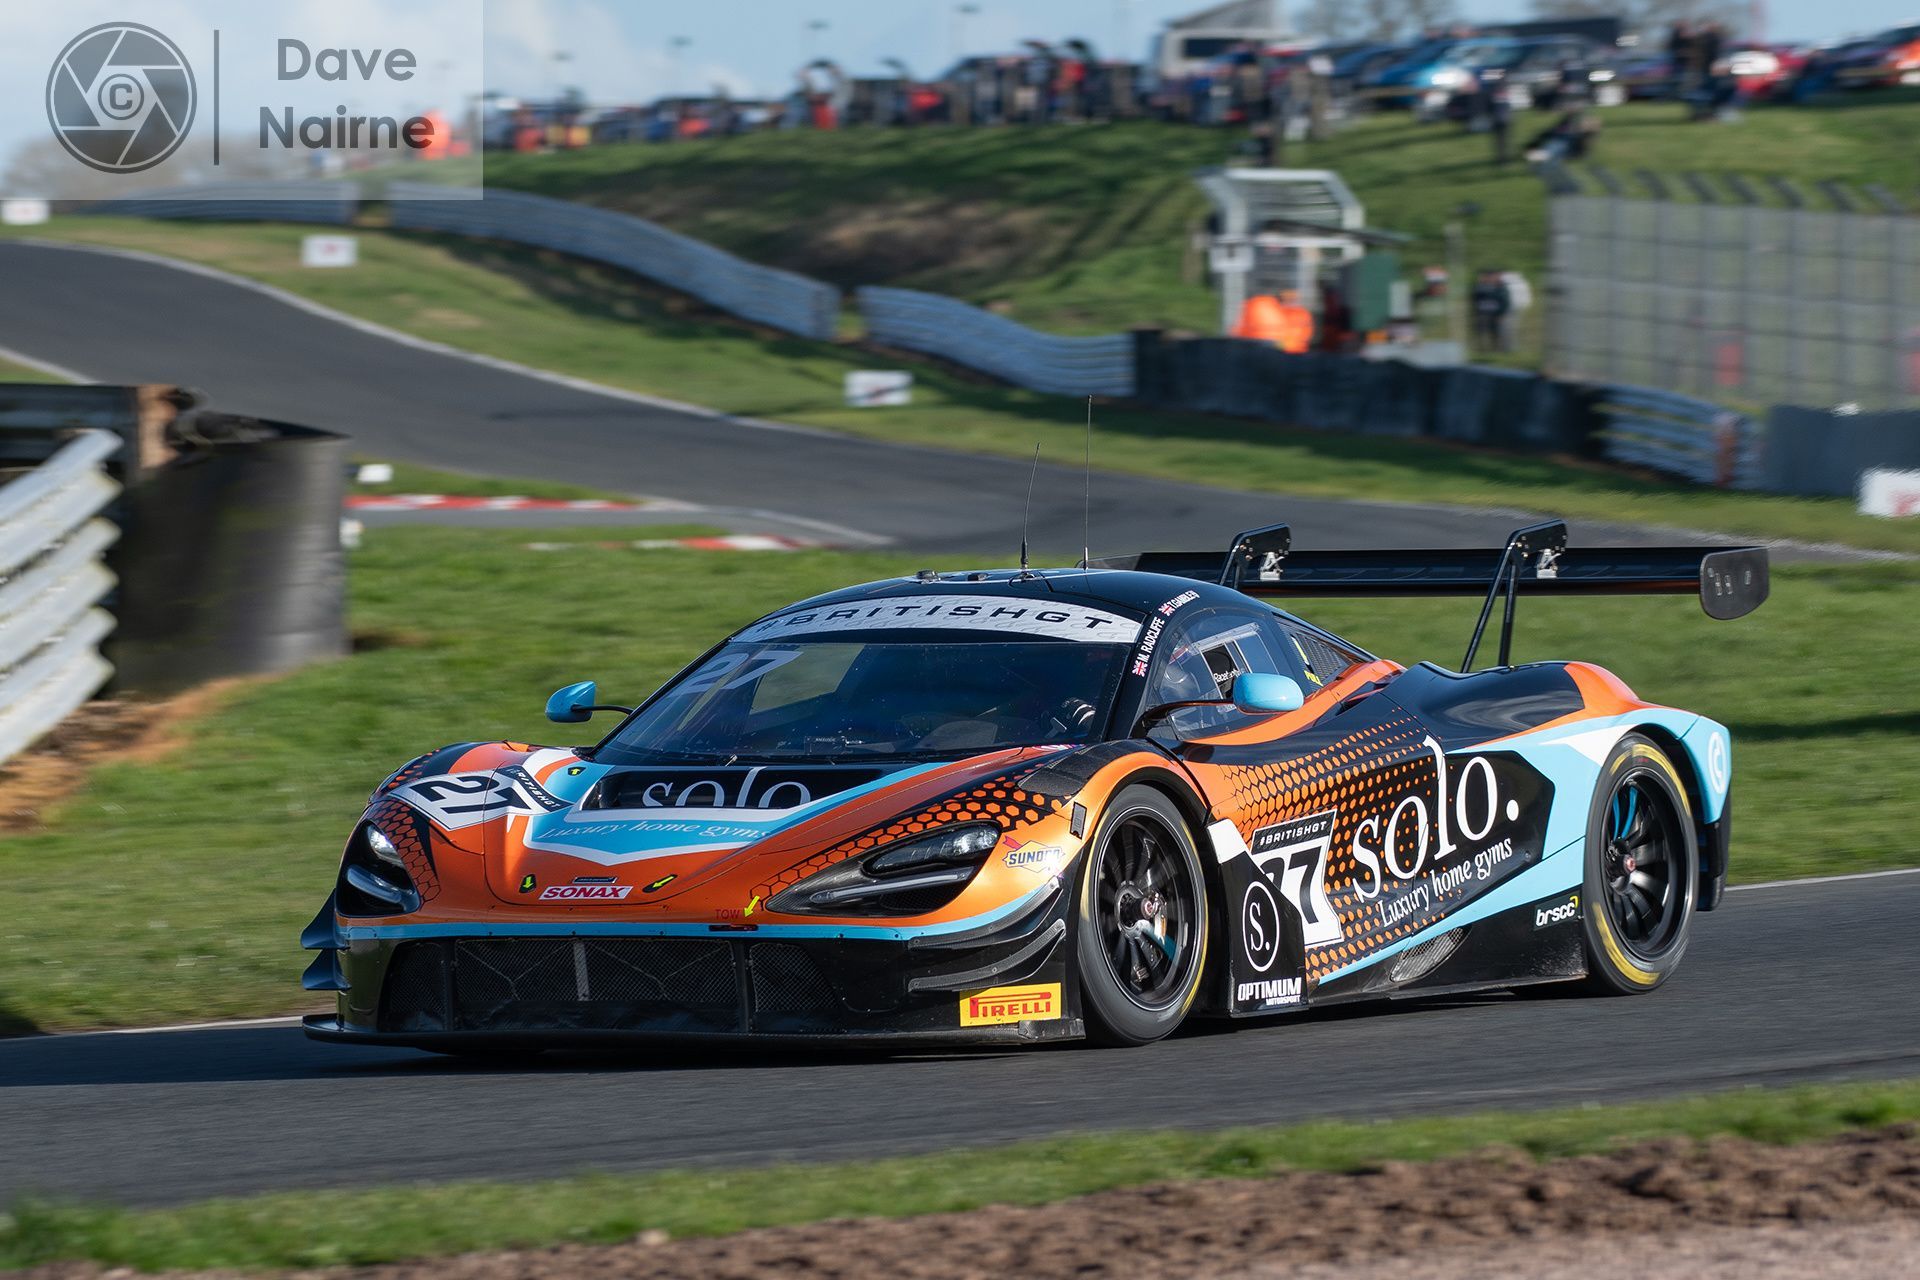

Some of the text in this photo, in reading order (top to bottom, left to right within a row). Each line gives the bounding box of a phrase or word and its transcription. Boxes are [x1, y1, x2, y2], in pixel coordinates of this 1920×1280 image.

[757, 605, 1113, 632] #BRITISHGT
[1141, 616, 1165, 654] RADCLIFFE
[629, 820, 700, 833] home
[698, 824, 768, 838] gyms
[1352, 735, 1519, 903] solo.
[1259, 820, 1328, 846] #BRITISHGT
[543, 887, 625, 898] SONAX
[1378, 837, 1513, 927] Luxury home gyms
[715, 908, 740, 919] TOW
[1535, 898, 1577, 927] brscc
[1237, 977, 1302, 1001] OPTIMUM
[969, 992, 1052, 1018] PIRELLI
